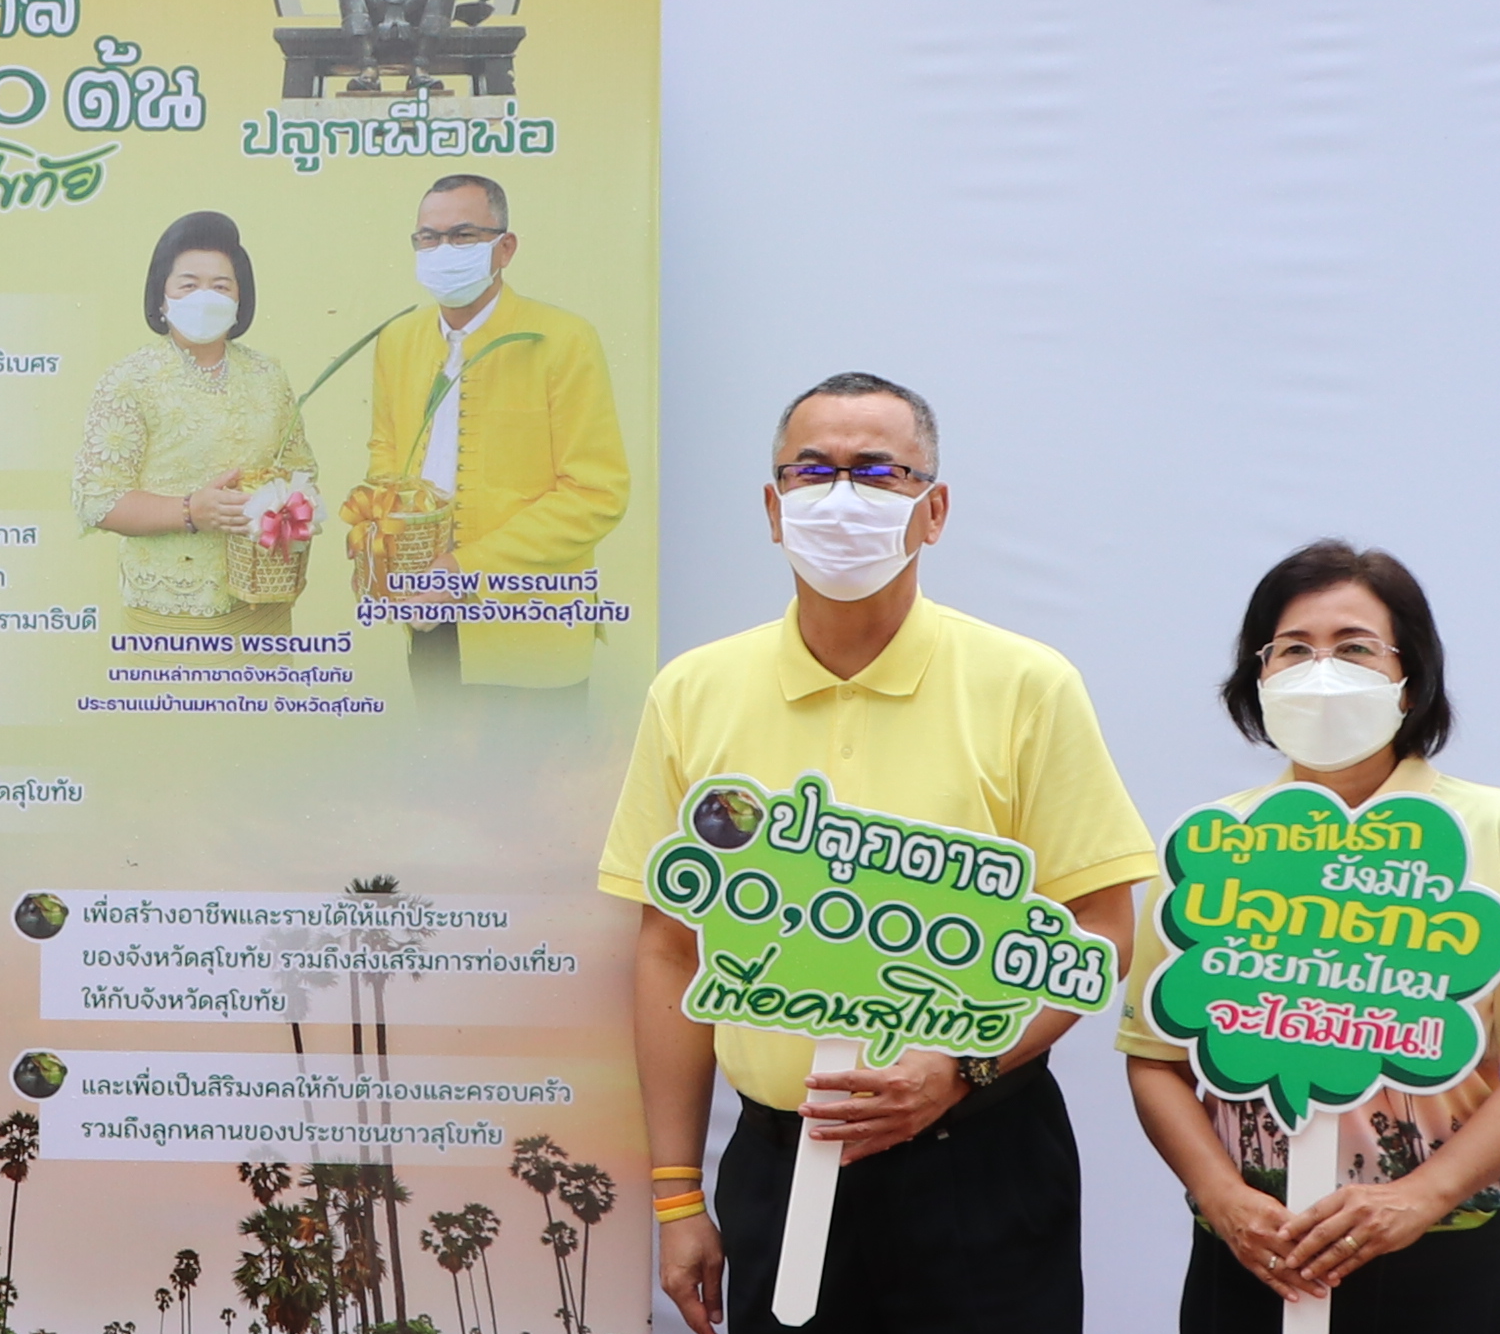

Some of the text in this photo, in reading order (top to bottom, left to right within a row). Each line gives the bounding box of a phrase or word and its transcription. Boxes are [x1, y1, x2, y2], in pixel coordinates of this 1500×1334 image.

[64, 35, 205, 130] ต้น
[242, 88, 555, 174] ปลูกเพื่อพ่อ
[488, 570, 598, 591] พรรณเทวี
[357, 597, 629, 628] ผู้ว่าราชการจังหวัดสุโขทัย
[111, 632, 352, 653] นางกนกพร พรรณเทวี
[109, 666, 353, 687] นายกเหล่ากาชาดจังหวัดสุโขทัย
[77, 694, 384, 717] ประธานแม่บ้านมหาดไทย จังหวัดสุโขทัย
[768, 782, 1022, 900] ปลูกตาล
[1187, 810, 1422, 864] ปลูกต้นรัก
[1321, 854, 1454, 902] ยังมีใจ
[82, 898, 508, 931] เพื่อสร้างอาชีพและรายได้ให้แก่ประชาชน
[656, 845, 1106, 1004] ๑๐,๐๐๐ ต้น
[1184, 879, 1480, 955] ปลูกตาล
[82, 942, 576, 977] ของจังหวัดสุโขทัย รวมถึงส่งเสริมการท่องเที่ยว
[1202, 936, 1450, 1001] ด้วยกันไหม
[81, 986, 286, 1018] ให้กับจังหวัดสุโขทัย
[697, 943, 1032, 1059] เพื่อคนสุโขทัย
[1207, 993, 1444, 1060] จะได้มีกัน!!
[81, 1069, 572, 1104] และเพื่อเป็นสิริมงคลให้กับตัวเองและครอบครัว
[81, 1117, 503, 1149] รวมถึงลูกหลานของประชาชนชาวสุโขทัย
